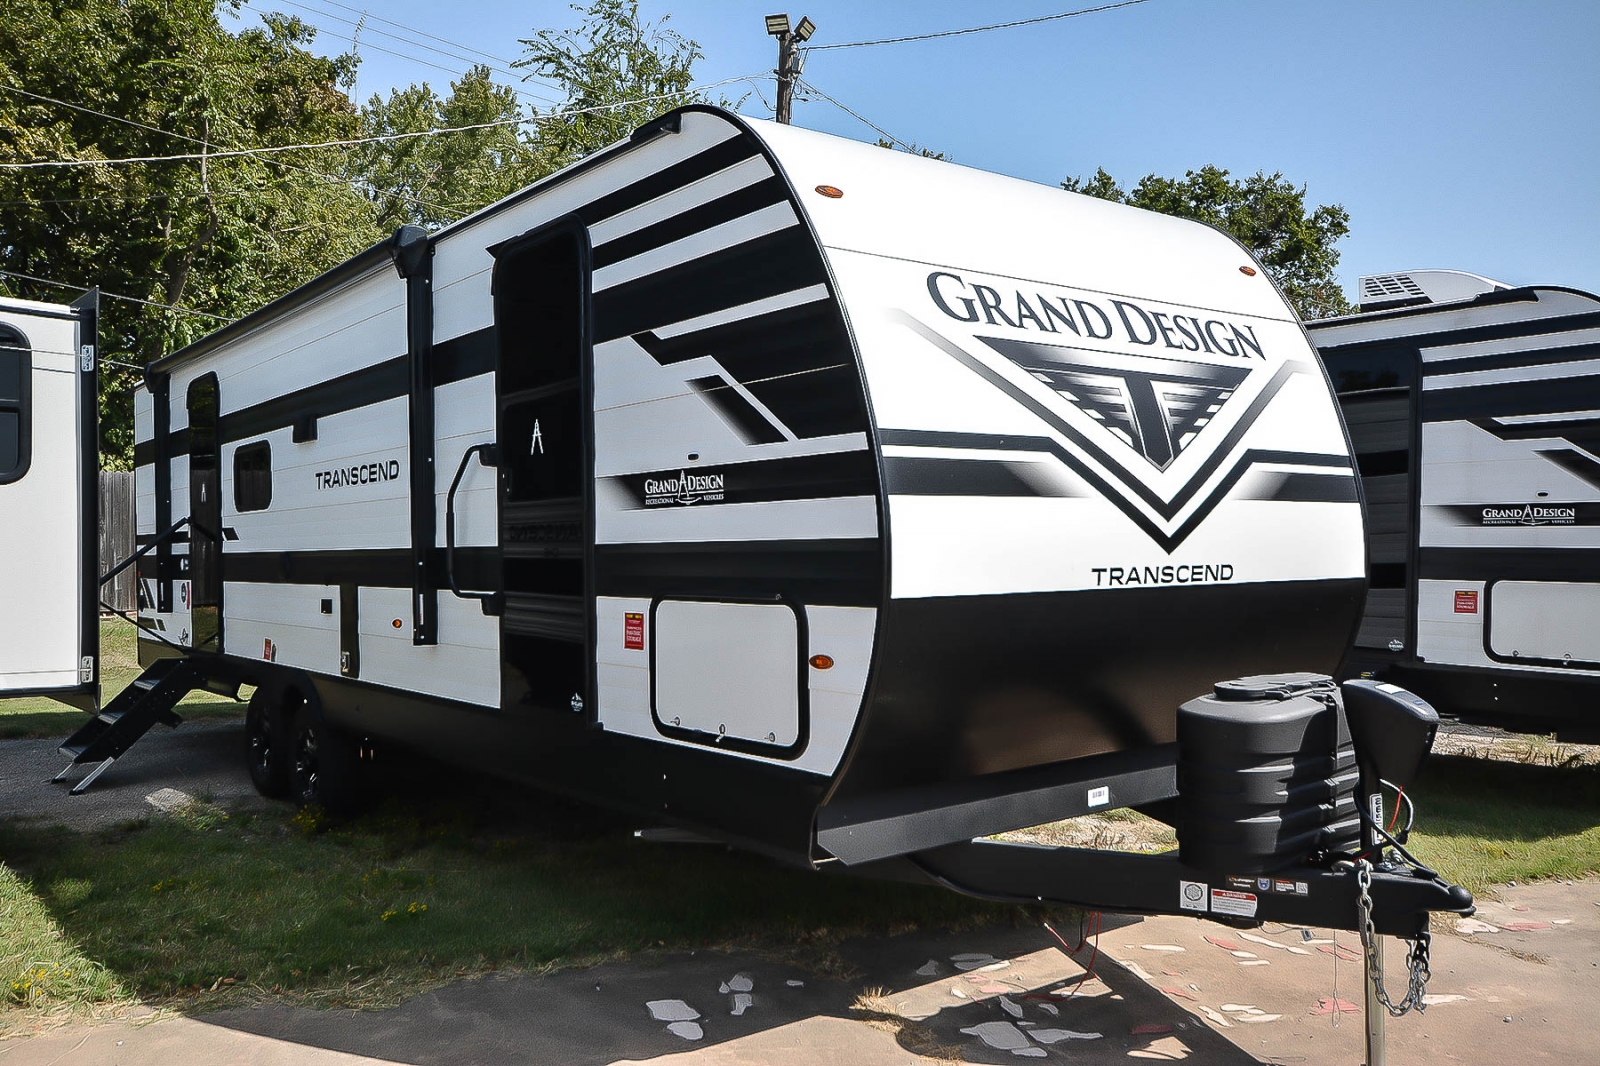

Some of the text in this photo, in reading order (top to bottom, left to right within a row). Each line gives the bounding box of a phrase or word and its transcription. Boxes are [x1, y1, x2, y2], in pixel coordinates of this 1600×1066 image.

[926, 271, 1266, 361] GRAND DESIGN
[315, 459, 400, 490] TRANSCEND
[644, 474, 724, 494] GRAND DESIGN
[1482, 507, 1575, 518] GRAND DESIGN
[1091, 564, 1234, 588] TRANSCEND
